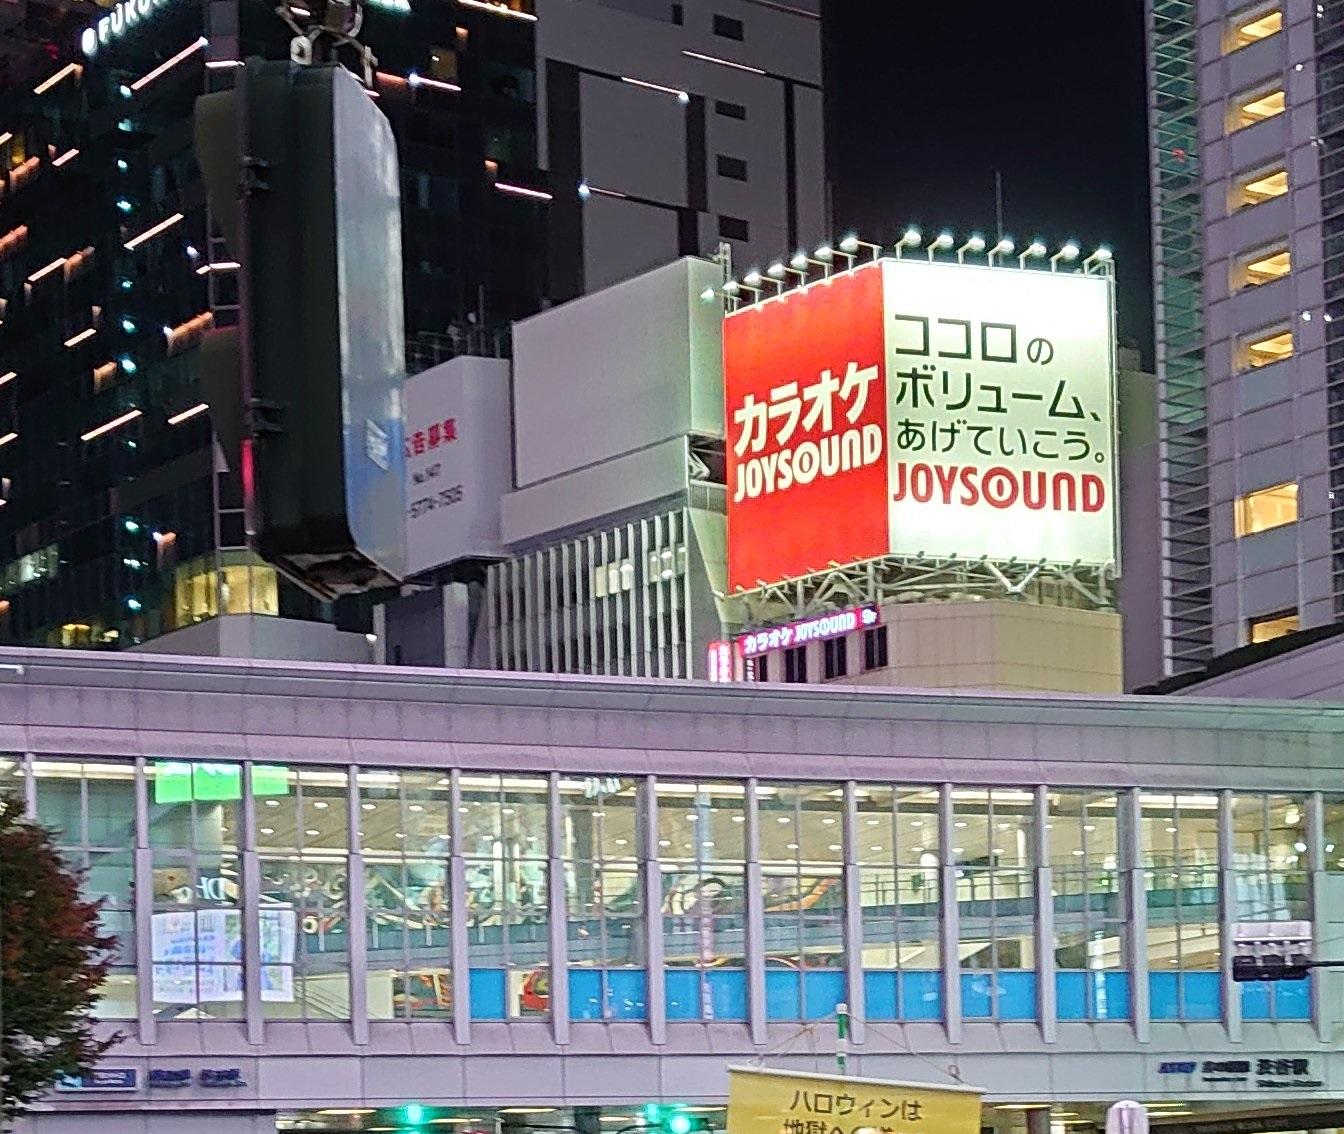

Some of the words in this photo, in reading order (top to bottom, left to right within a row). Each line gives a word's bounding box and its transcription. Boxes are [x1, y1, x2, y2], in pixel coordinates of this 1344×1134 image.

[895, 312, 1055, 365] ココロの
[734, 360, 880, 458] カラオケ
[895, 363, 1103, 423] ボリューム、
[734, 424, 884, 503] JOYSOUND
[896, 417, 1106, 465] あげていこう。
[893, 463, 1106, 513] JOYSOUND
[744, 627, 793, 655] カラオケ
[795, 611, 856, 642] JOYSOUND
[789, 1090, 924, 1122] ハロウィンは
